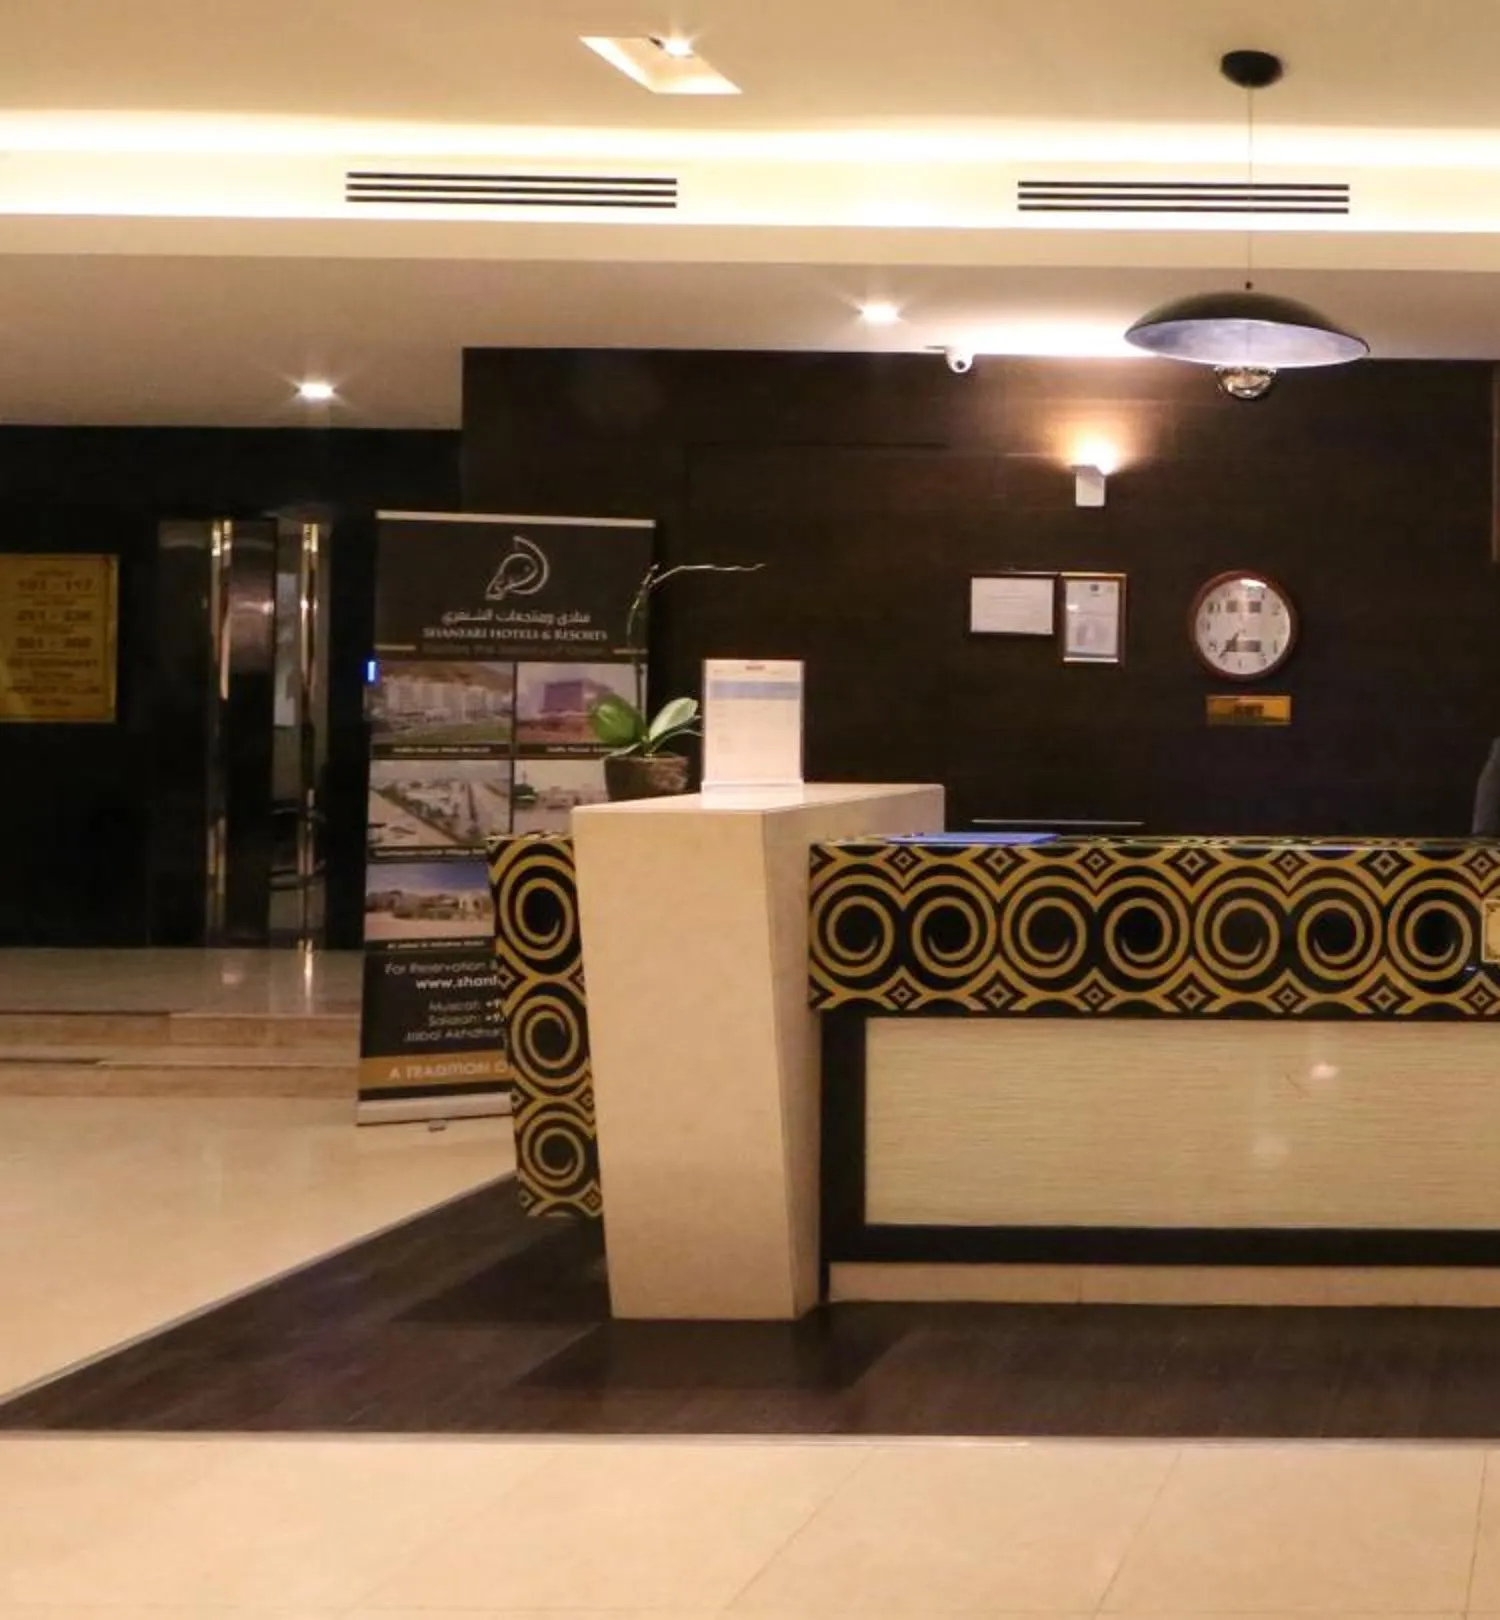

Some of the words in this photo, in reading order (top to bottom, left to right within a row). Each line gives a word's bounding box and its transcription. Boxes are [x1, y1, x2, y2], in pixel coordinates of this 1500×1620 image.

[489, 628, 538, 640] HOTELS
[554, 629, 608, 641] RESORTS
[385, 962, 406, 975] For
[409, 960, 487, 974] Reservation
[415, 974, 501, 989] www.shanf
[388, 1067, 401, 1079] A
[406, 1061, 490, 1078] TRADITION
